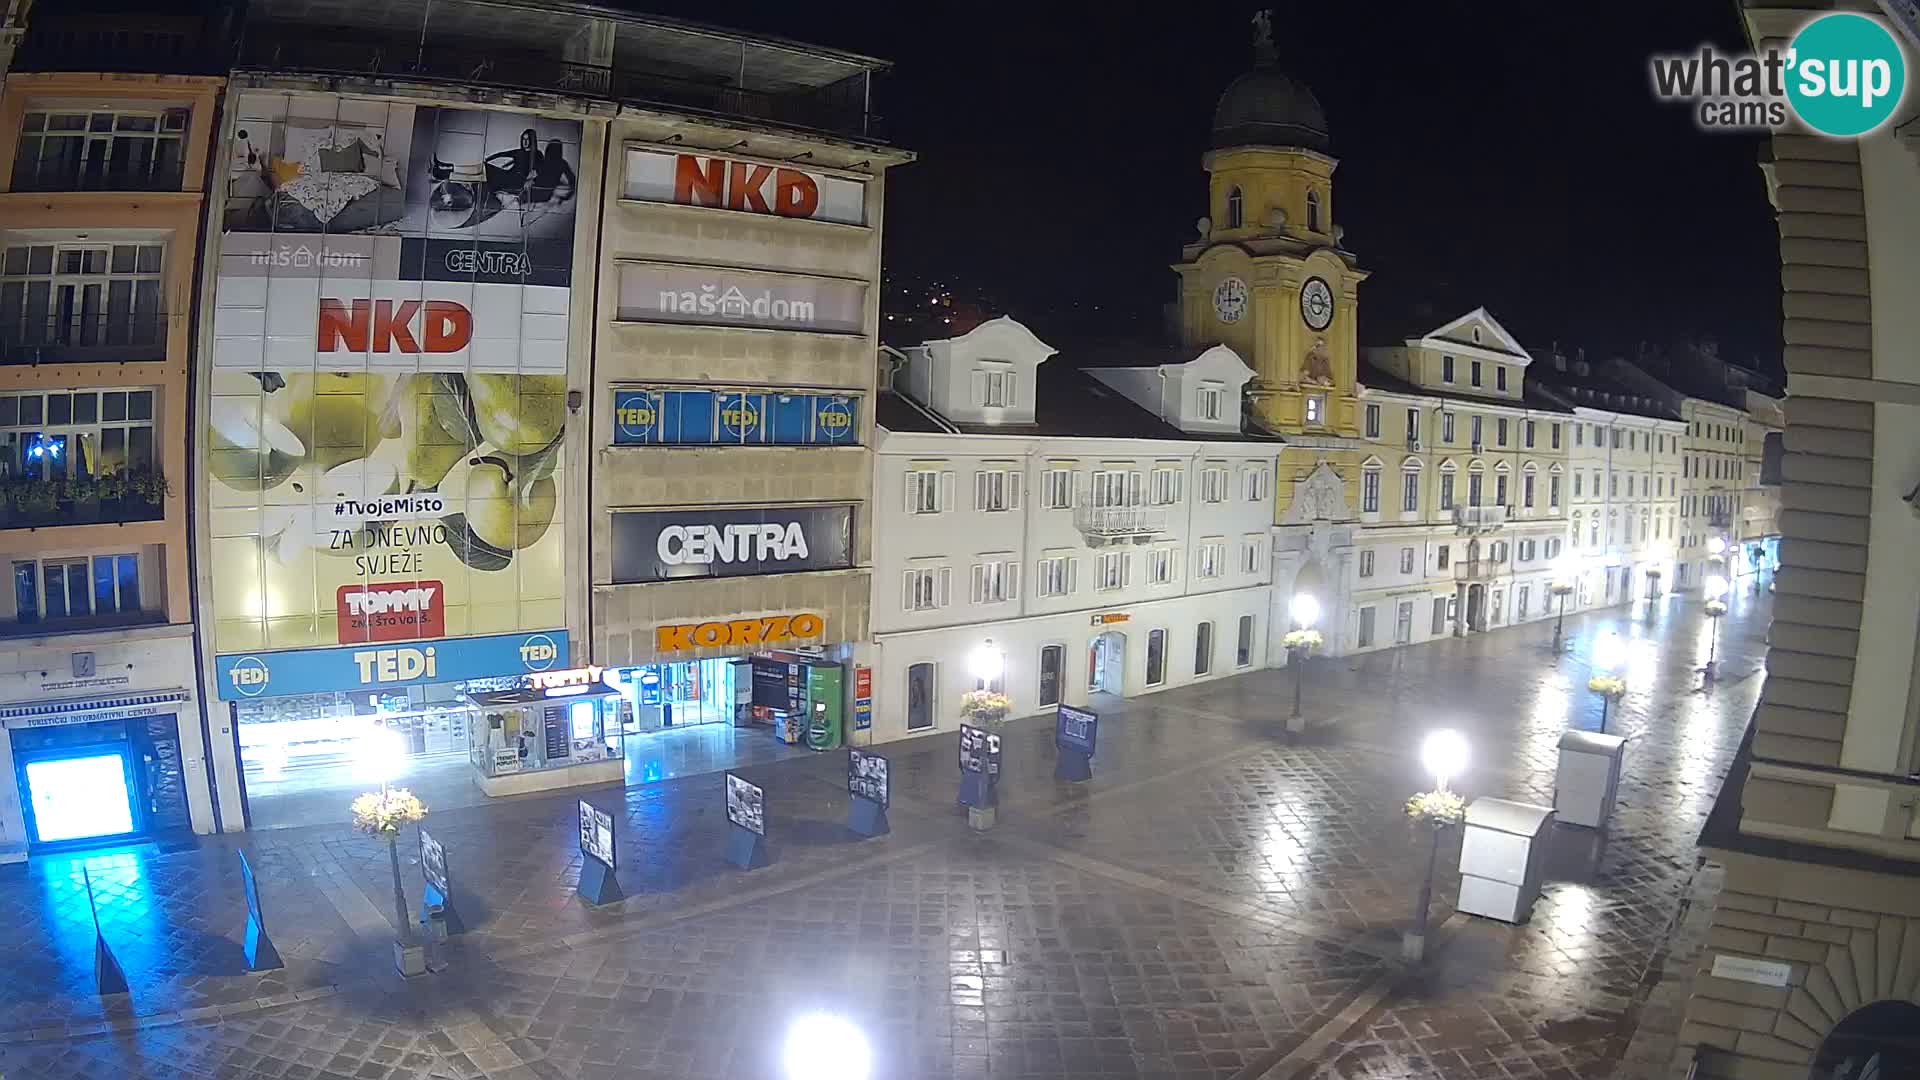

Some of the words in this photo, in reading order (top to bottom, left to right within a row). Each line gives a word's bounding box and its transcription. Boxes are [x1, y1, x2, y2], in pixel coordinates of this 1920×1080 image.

[675, 154, 819, 218] NKD
[251, 246, 291, 266] naš
[316, 247, 361, 268] dom
[445, 249, 532, 275] CENTRA
[659, 284, 715, 315] naš
[753, 291, 815, 321] dom
[317, 298, 473, 353] NKD
[616, 408, 656, 425] TEDi
[721, 409, 758, 426] TEDi
[819, 412, 851, 427] TEDi
[334, 498, 443, 517] #TvojeMisto
[330, 529, 354, 550] ZA
[365, 524, 448, 549] DNEVNO
[656, 522, 809, 566] CENTRA
[355, 549, 423, 577] SVJEŽE
[345, 587, 435, 616] TOMMY
[656, 613, 824, 652] KORZO
[353, 646, 437, 684] TEDi
[519, 644, 558, 662] TEDi
[229, 667, 269, 686] TEDi
